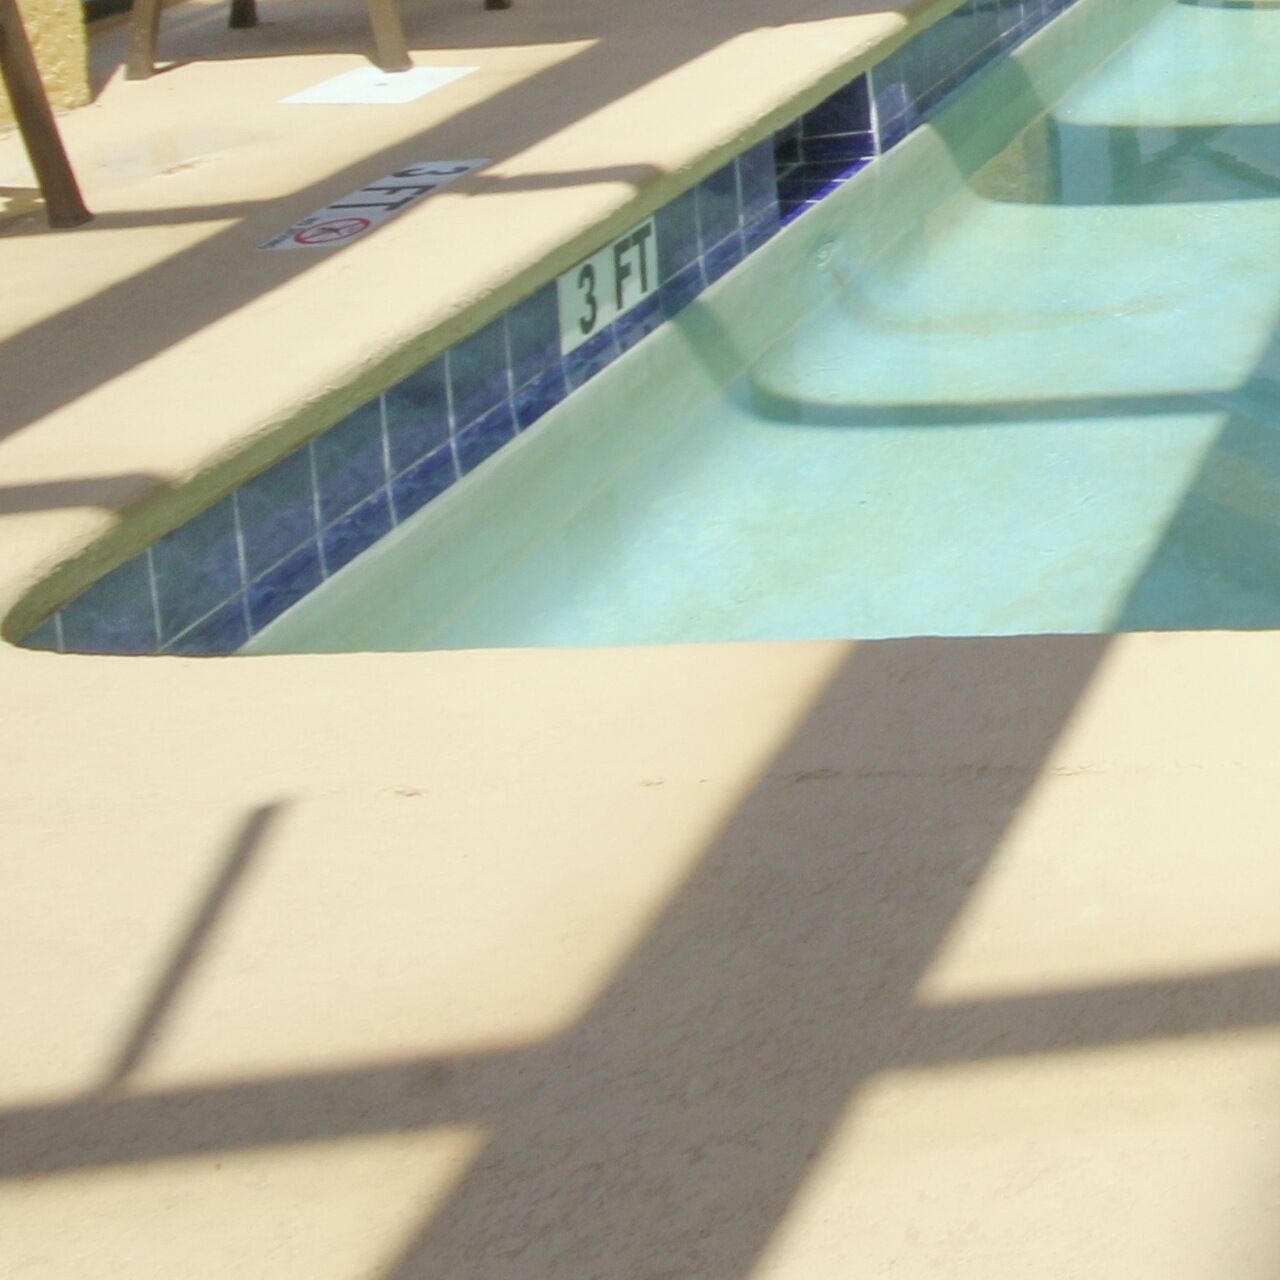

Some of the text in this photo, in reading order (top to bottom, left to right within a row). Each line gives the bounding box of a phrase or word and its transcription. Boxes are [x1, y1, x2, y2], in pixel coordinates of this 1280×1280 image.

[328, 166, 470, 211] 3 FT
[578, 223, 653, 335] 3 FT
